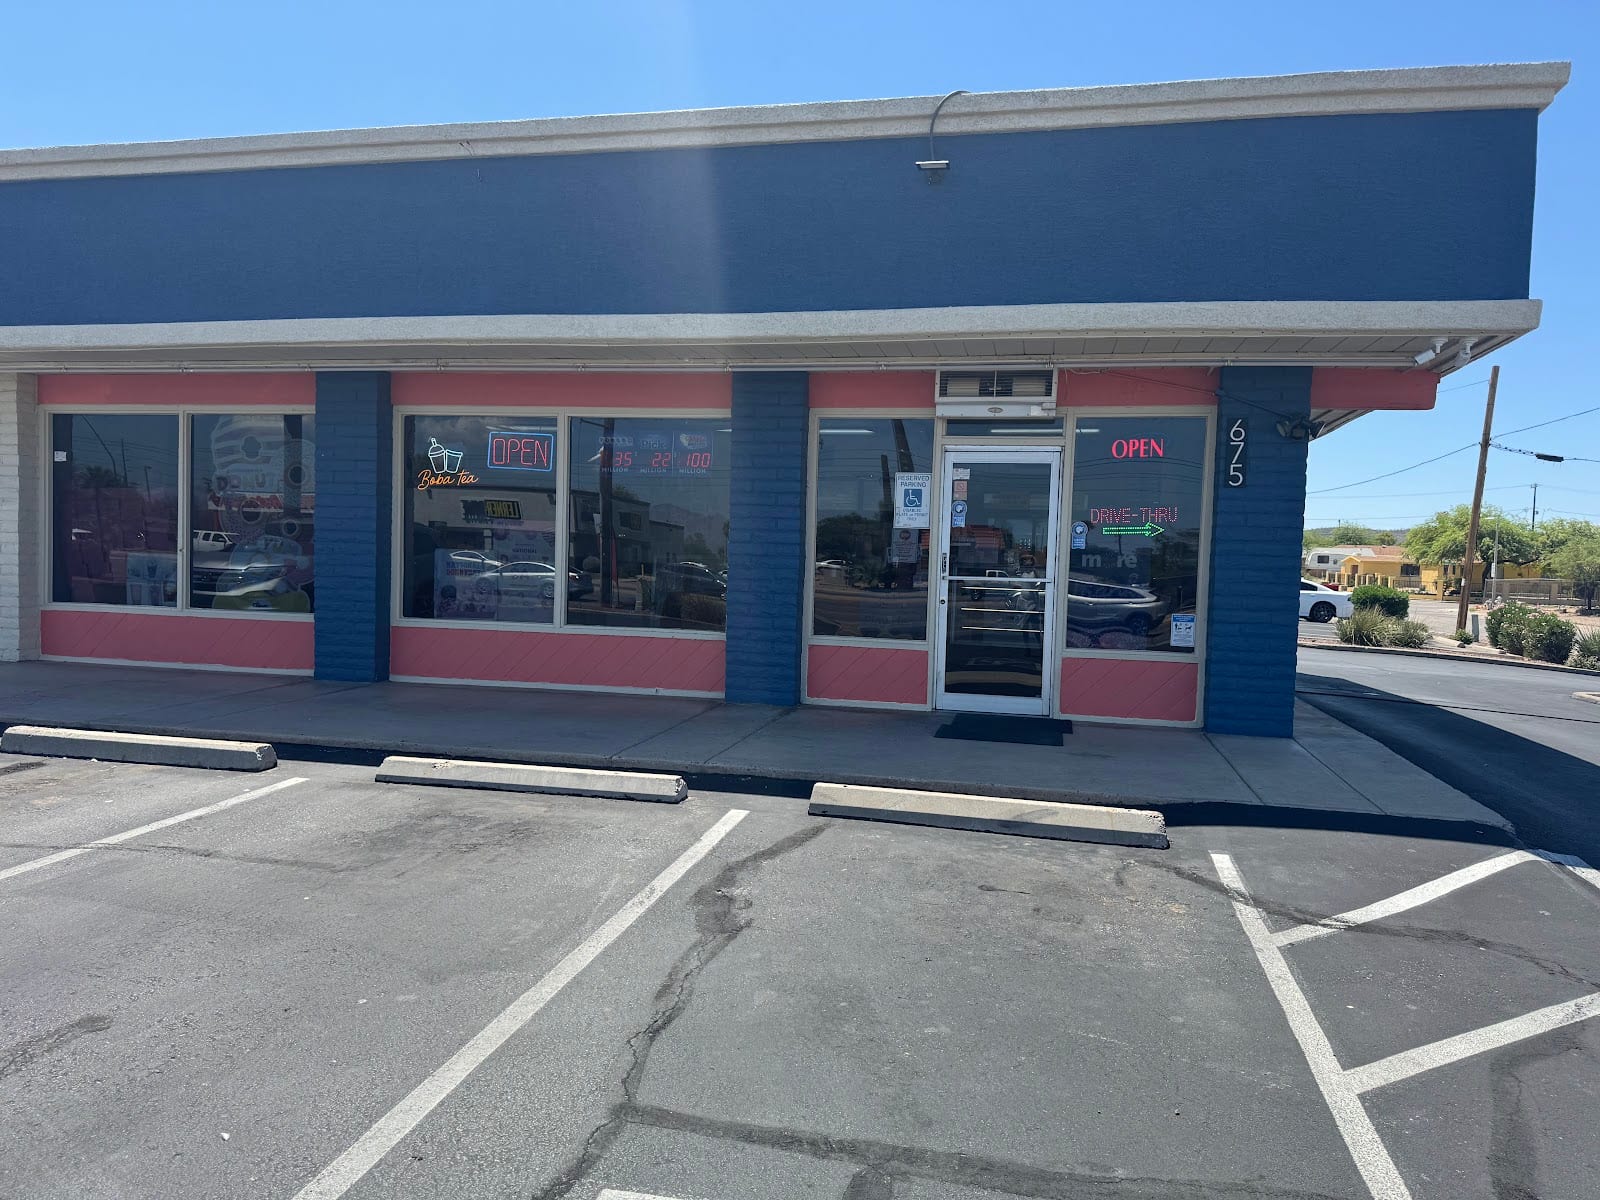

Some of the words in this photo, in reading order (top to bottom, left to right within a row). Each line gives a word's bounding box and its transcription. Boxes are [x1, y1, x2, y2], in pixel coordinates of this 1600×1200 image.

[493, 438, 548, 467] OPEN
[1111, 438, 1164, 459] OPEN
[1228, 418, 1246, 487] 675
[614, 451, 633, 467] 35
[651, 452, 672, 467] 22
[686, 452, 711, 468] 100
[640, 466, 667, 474] MILLION
[417, 469, 455, 490] Boba
[1090, 506, 1178, 524] DRIVE-THRU
[1081, 554, 1137, 568] mre
